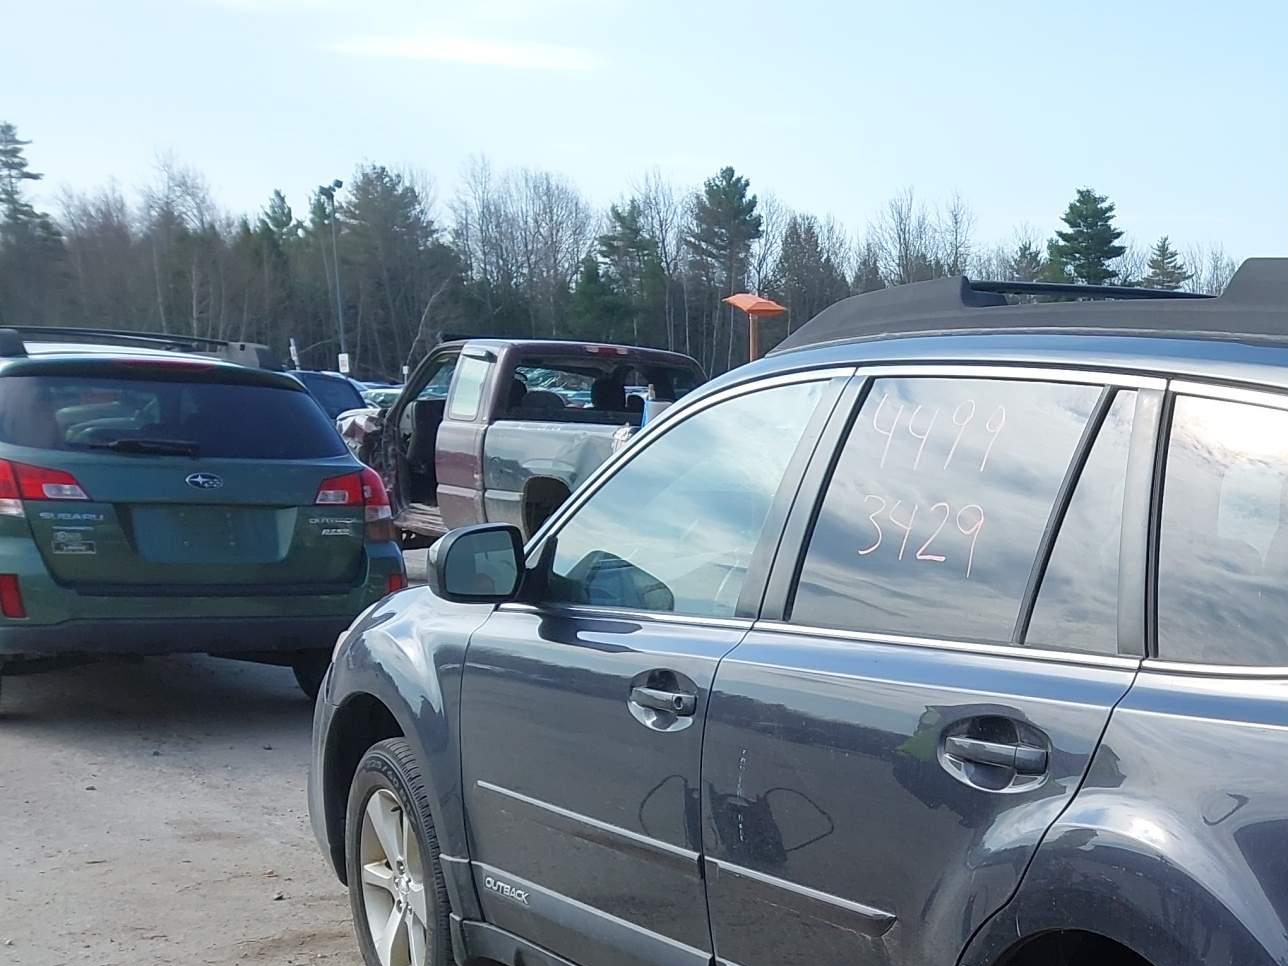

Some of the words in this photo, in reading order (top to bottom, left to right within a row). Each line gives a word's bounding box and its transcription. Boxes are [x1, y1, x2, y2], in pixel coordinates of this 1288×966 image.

[872, 393, 1006, 473] 4499
[857, 493, 985, 579] 3429
[485, 876, 530, 905] OUTBACK
